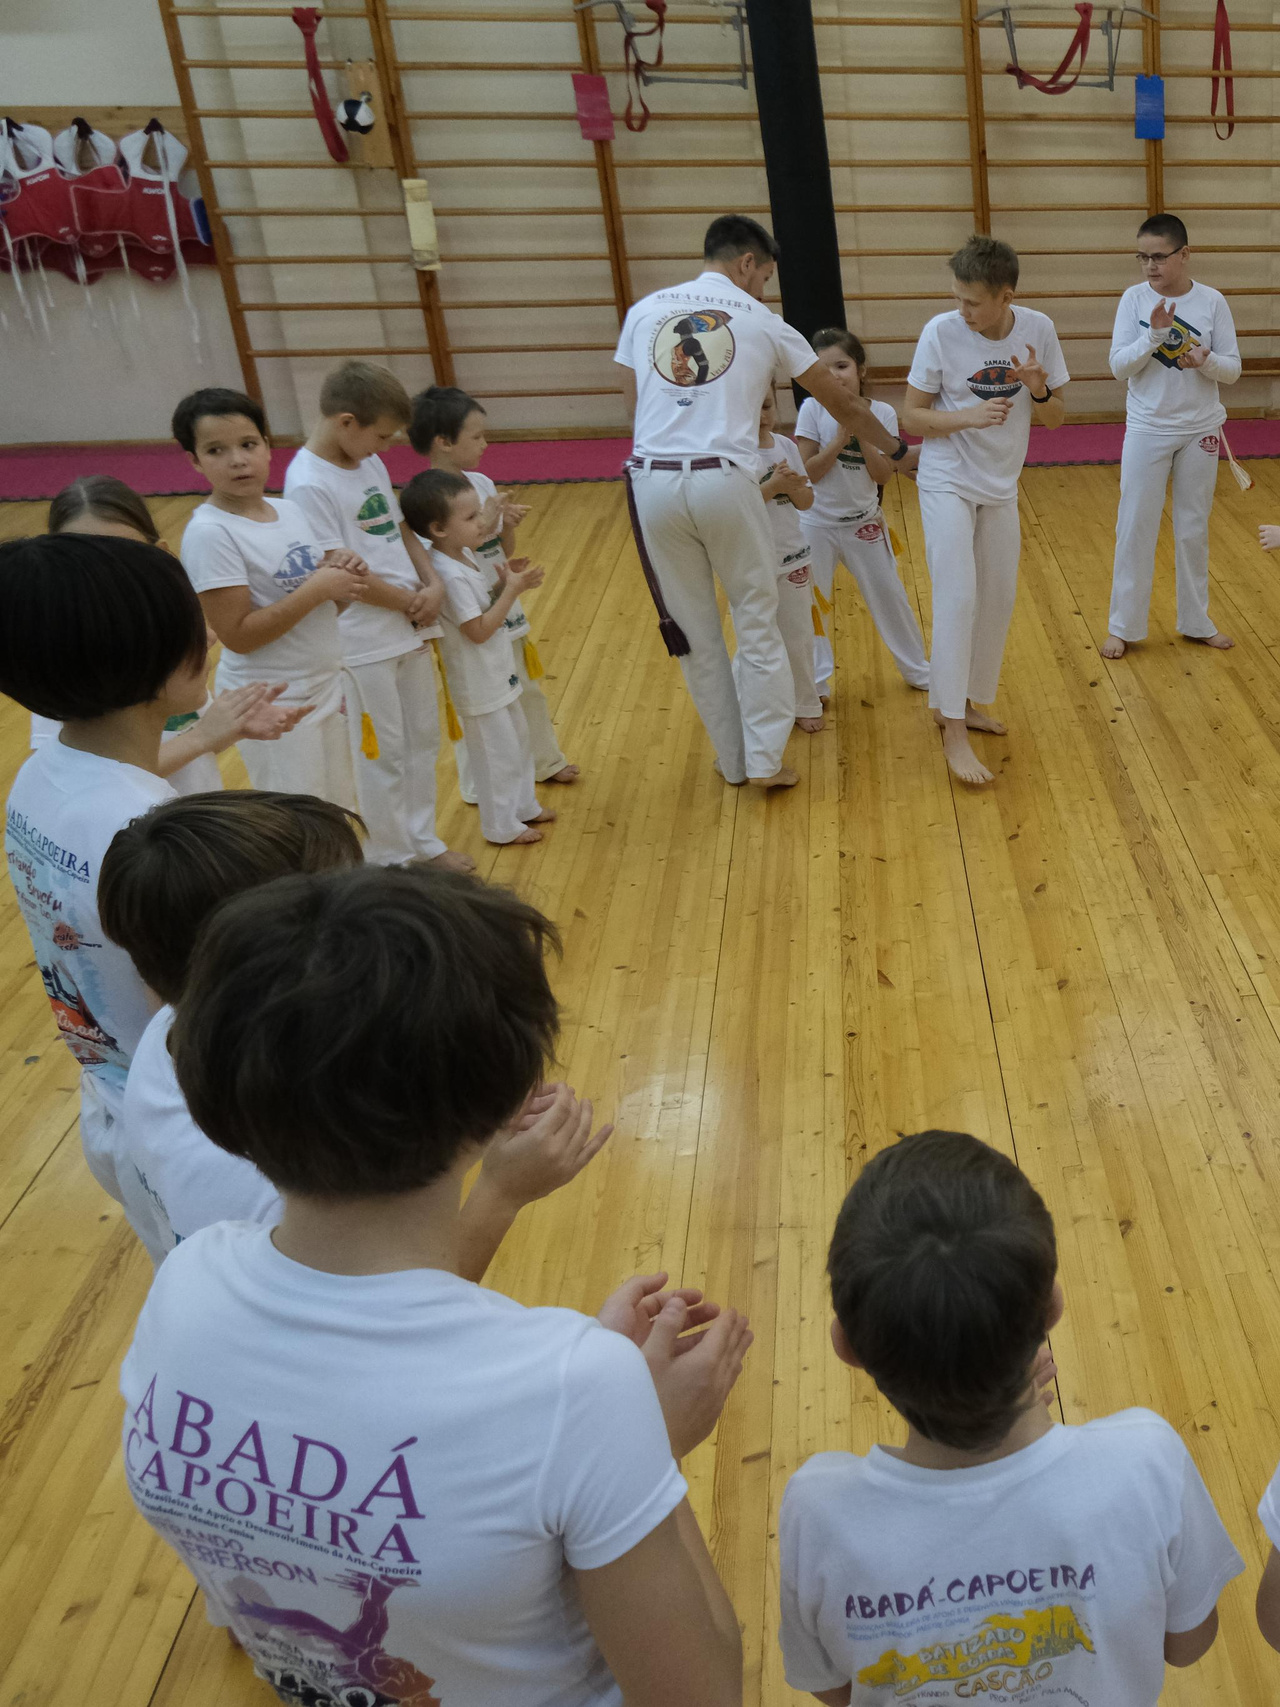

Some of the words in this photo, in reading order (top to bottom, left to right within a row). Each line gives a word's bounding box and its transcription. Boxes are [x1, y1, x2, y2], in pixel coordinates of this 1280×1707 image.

[134, 1371, 425, 1520] ABADÁ
[126, 1427, 421, 1564] CAPOEIRA
[245, 1520, 330, 1554] Desenvolvimento
[332, 1549, 343, 1559] da
[346, 1553, 422, 1576] Arte-Capoeira
[845, 1564, 1097, 1620] ABADÁ-CAPOEIRA
[918, 1627, 1026, 1664] BATIZADO
